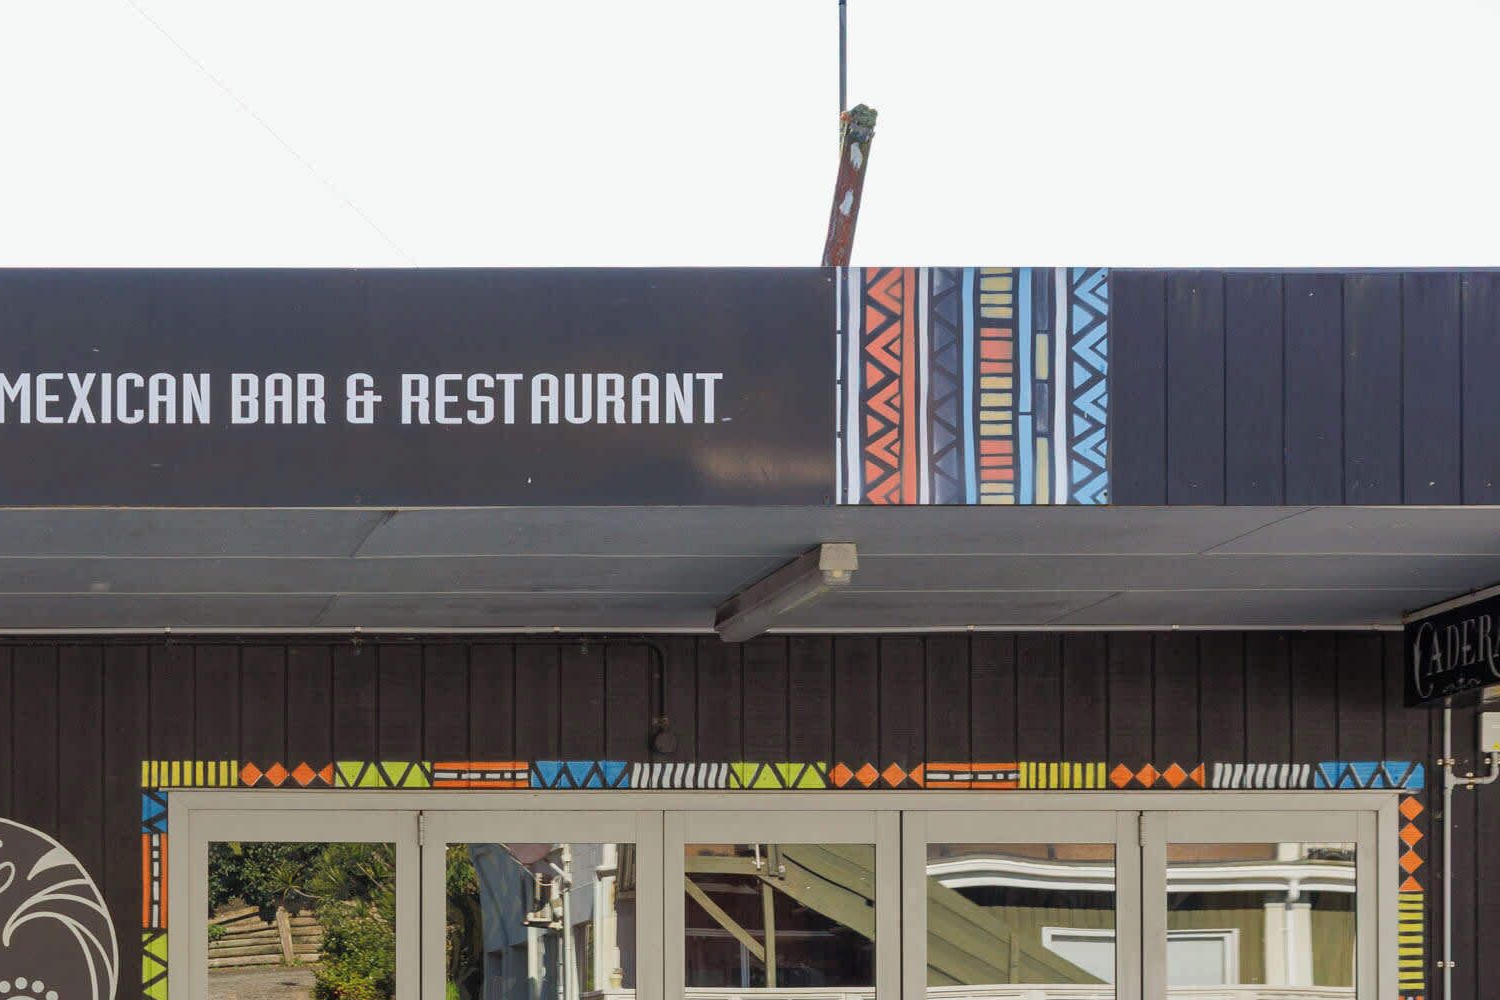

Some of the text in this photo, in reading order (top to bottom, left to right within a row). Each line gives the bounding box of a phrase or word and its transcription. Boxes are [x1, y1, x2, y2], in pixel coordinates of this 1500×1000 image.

[231, 372, 326, 425] BAR
[345, 372, 382, 425] &
[401, 372, 724, 425] RESTAURANT
